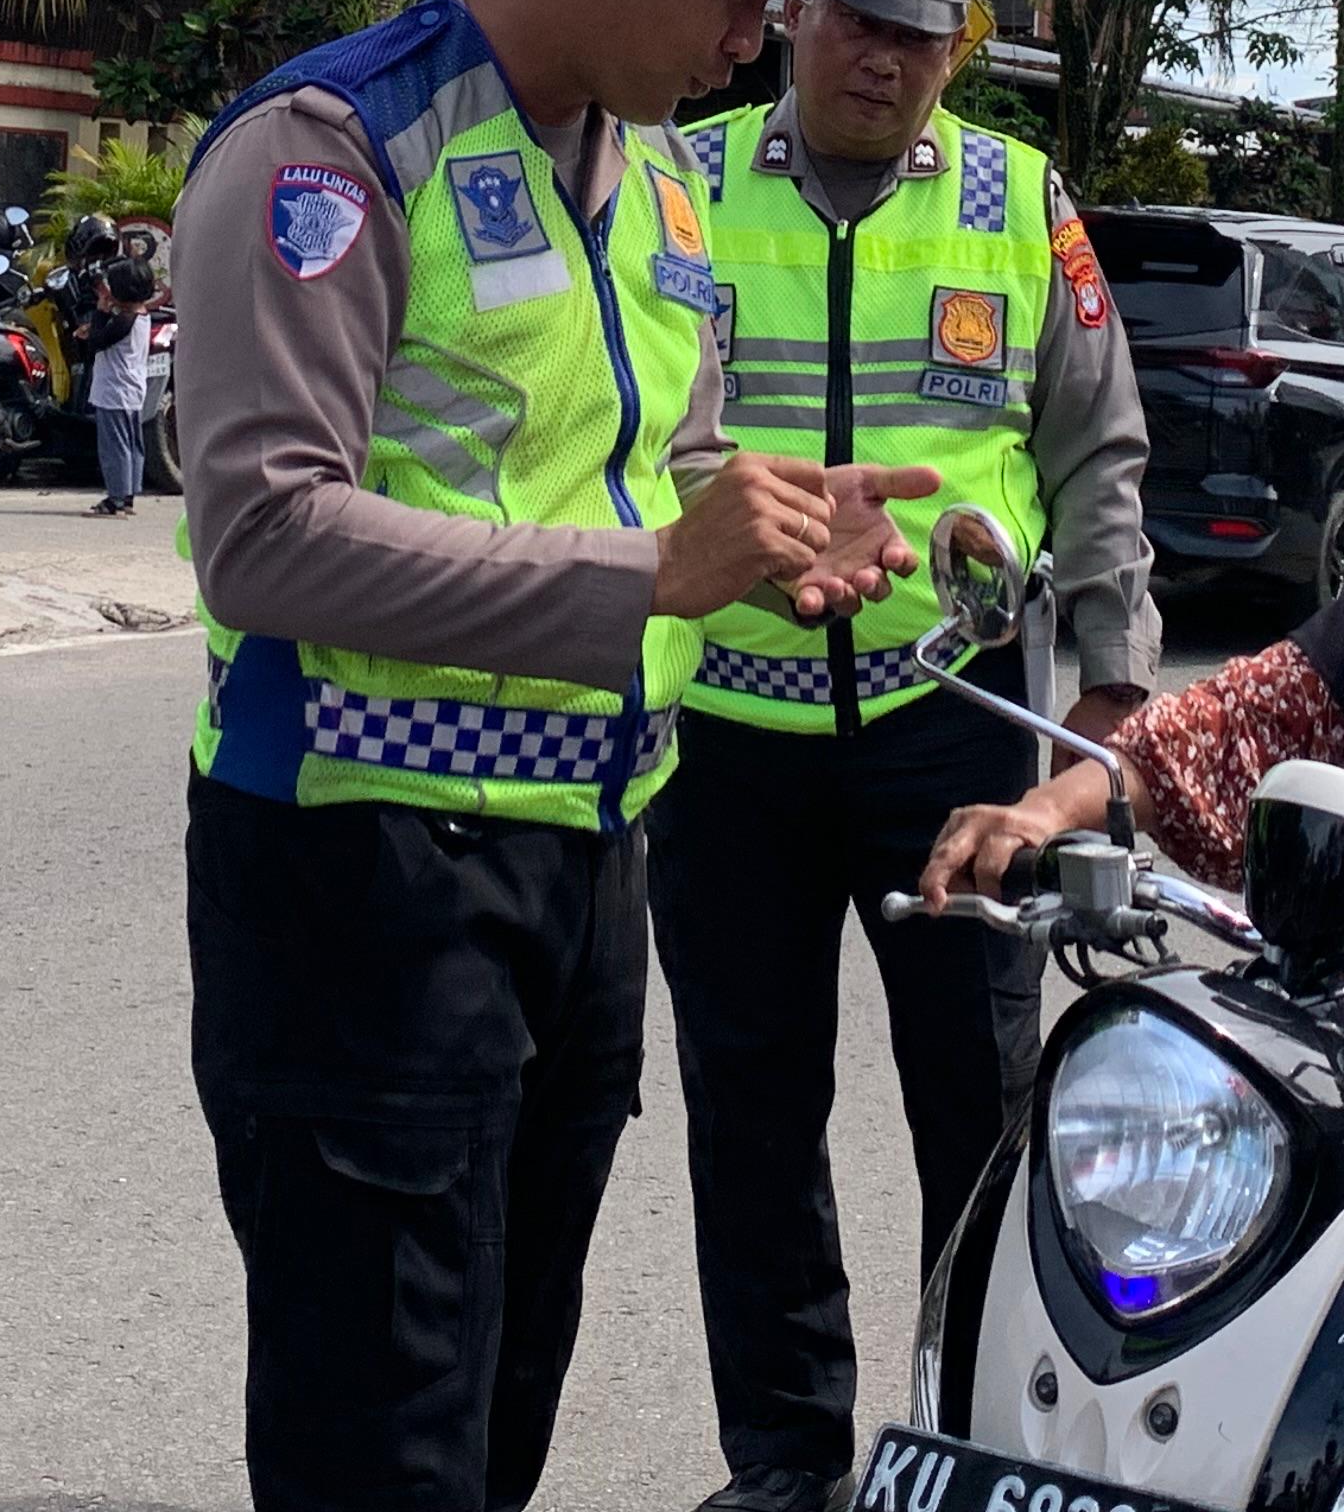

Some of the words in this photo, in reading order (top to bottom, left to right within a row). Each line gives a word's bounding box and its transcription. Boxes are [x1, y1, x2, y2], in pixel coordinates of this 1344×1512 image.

[283, 167, 322, 182] LALU
[322, 172, 367, 204] LINTAS
[658, 265, 712, 304] POLRI
[929, 375, 1000, 402] POLRI
[864, 1440, 956, 1512] KU
